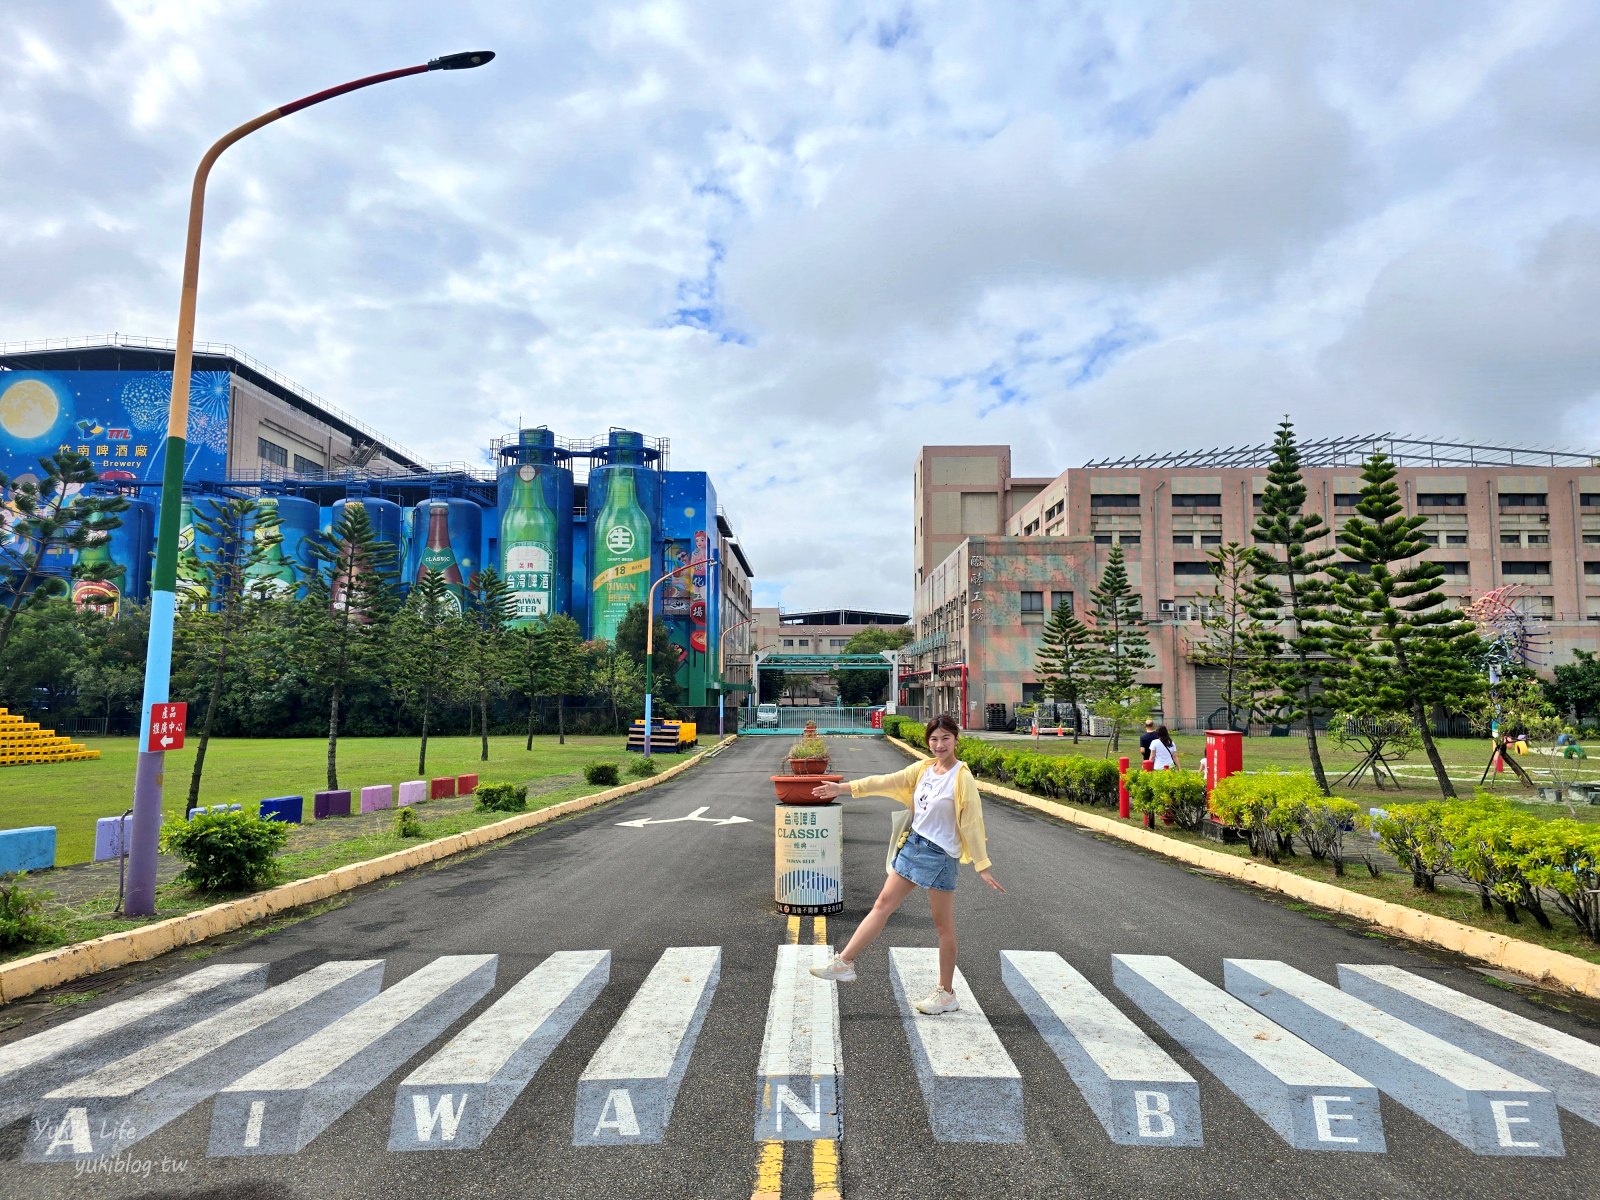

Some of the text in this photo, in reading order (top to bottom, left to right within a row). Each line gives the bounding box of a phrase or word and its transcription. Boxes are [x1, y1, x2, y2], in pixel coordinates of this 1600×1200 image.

[107, 429, 132, 439] TTL
[58, 444, 148, 457] 竹南啤酒廠
[103, 460, 142, 468] Brewery
[609, 528, 631, 549] 生
[614, 565, 626, 576] 18
[161, 706, 177, 719] 產品
[777, 828, 829, 839] CLASSIC
